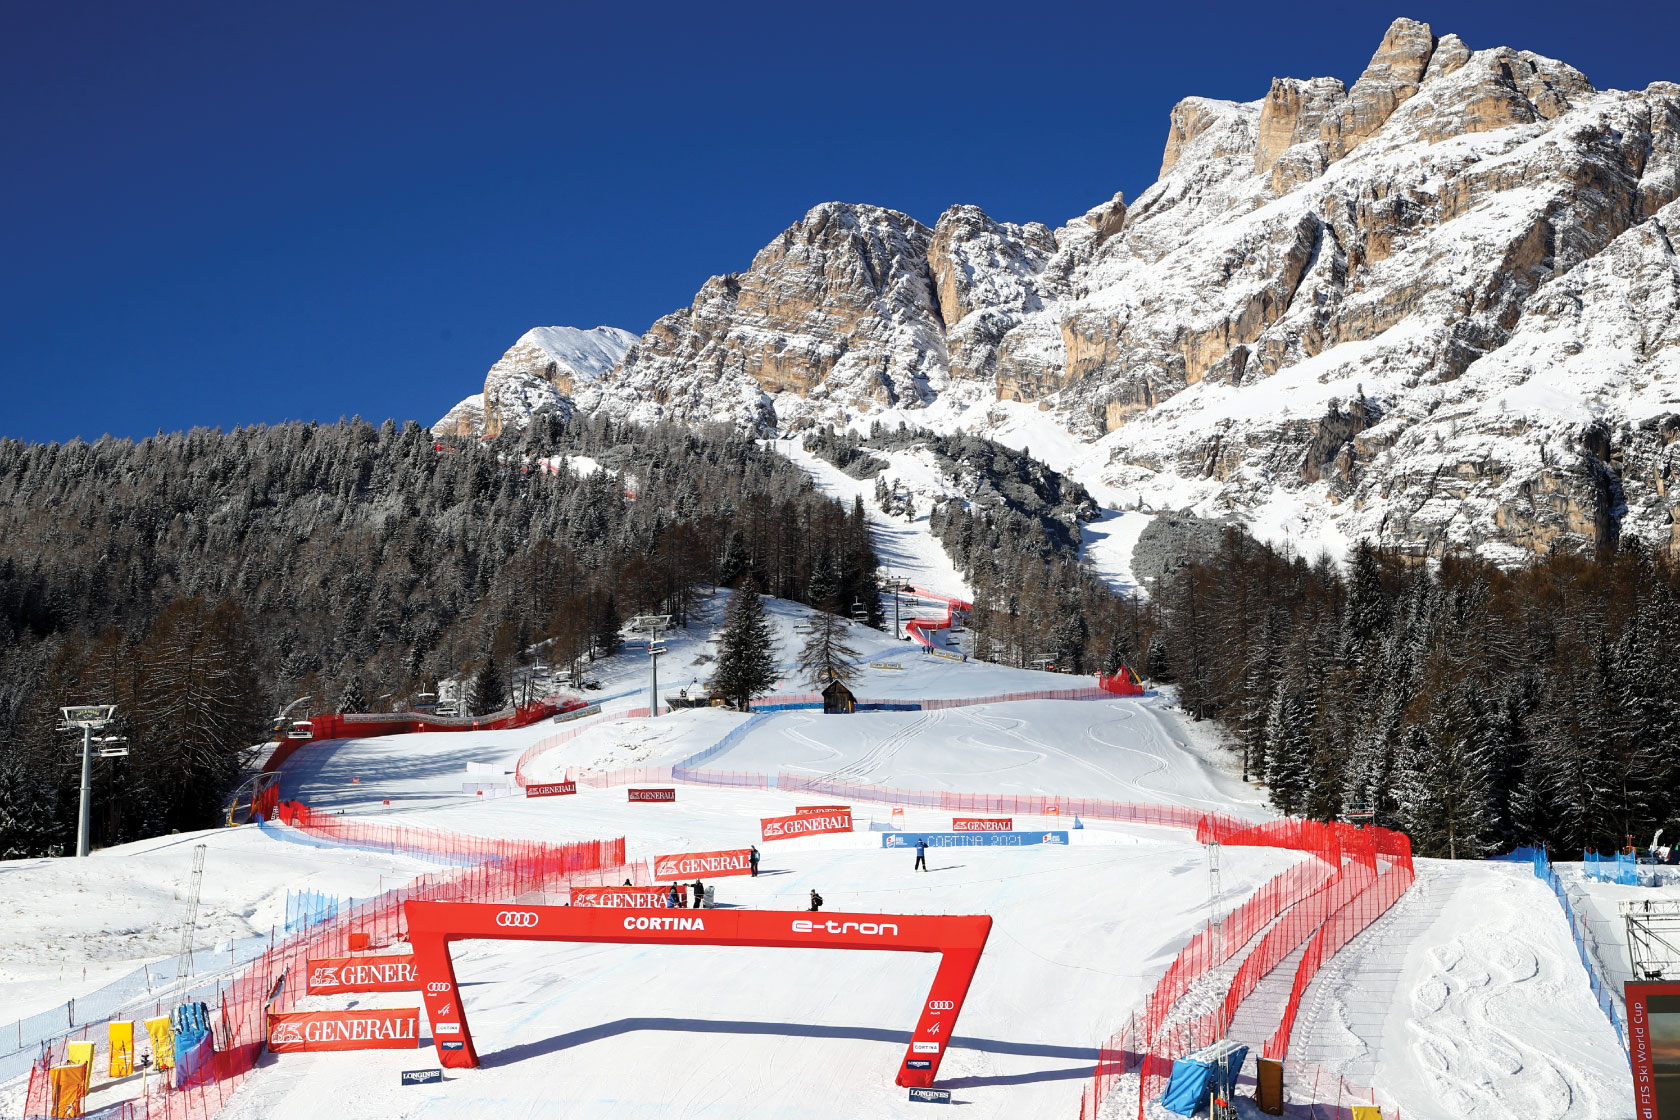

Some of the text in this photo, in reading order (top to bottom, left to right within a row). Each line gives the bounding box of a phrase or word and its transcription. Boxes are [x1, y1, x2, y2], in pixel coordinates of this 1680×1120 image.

[538, 785, 576, 795] GENERALI
[640, 792, 675, 800] GENERALI
[784, 816, 850, 834] GENERALI
[967, 821, 1012, 831] GENERALI
[927, 834, 1022, 848] CORTINA 2021
[623, 916, 705, 931] CORTINA
[791, 919, 899, 936] e-tron
[1633, 1002, 1644, 1024] Cup
[305, 1017, 416, 1042] GENERALI
[1635, 1027, 1647, 1063] World
[403, 1071, 440, 1080] LONGINES
[1639, 1066, 1648, 1082] Ski
[910, 1089, 949, 1099] LONGINES
[1641, 1086, 1650, 1104] FIS
